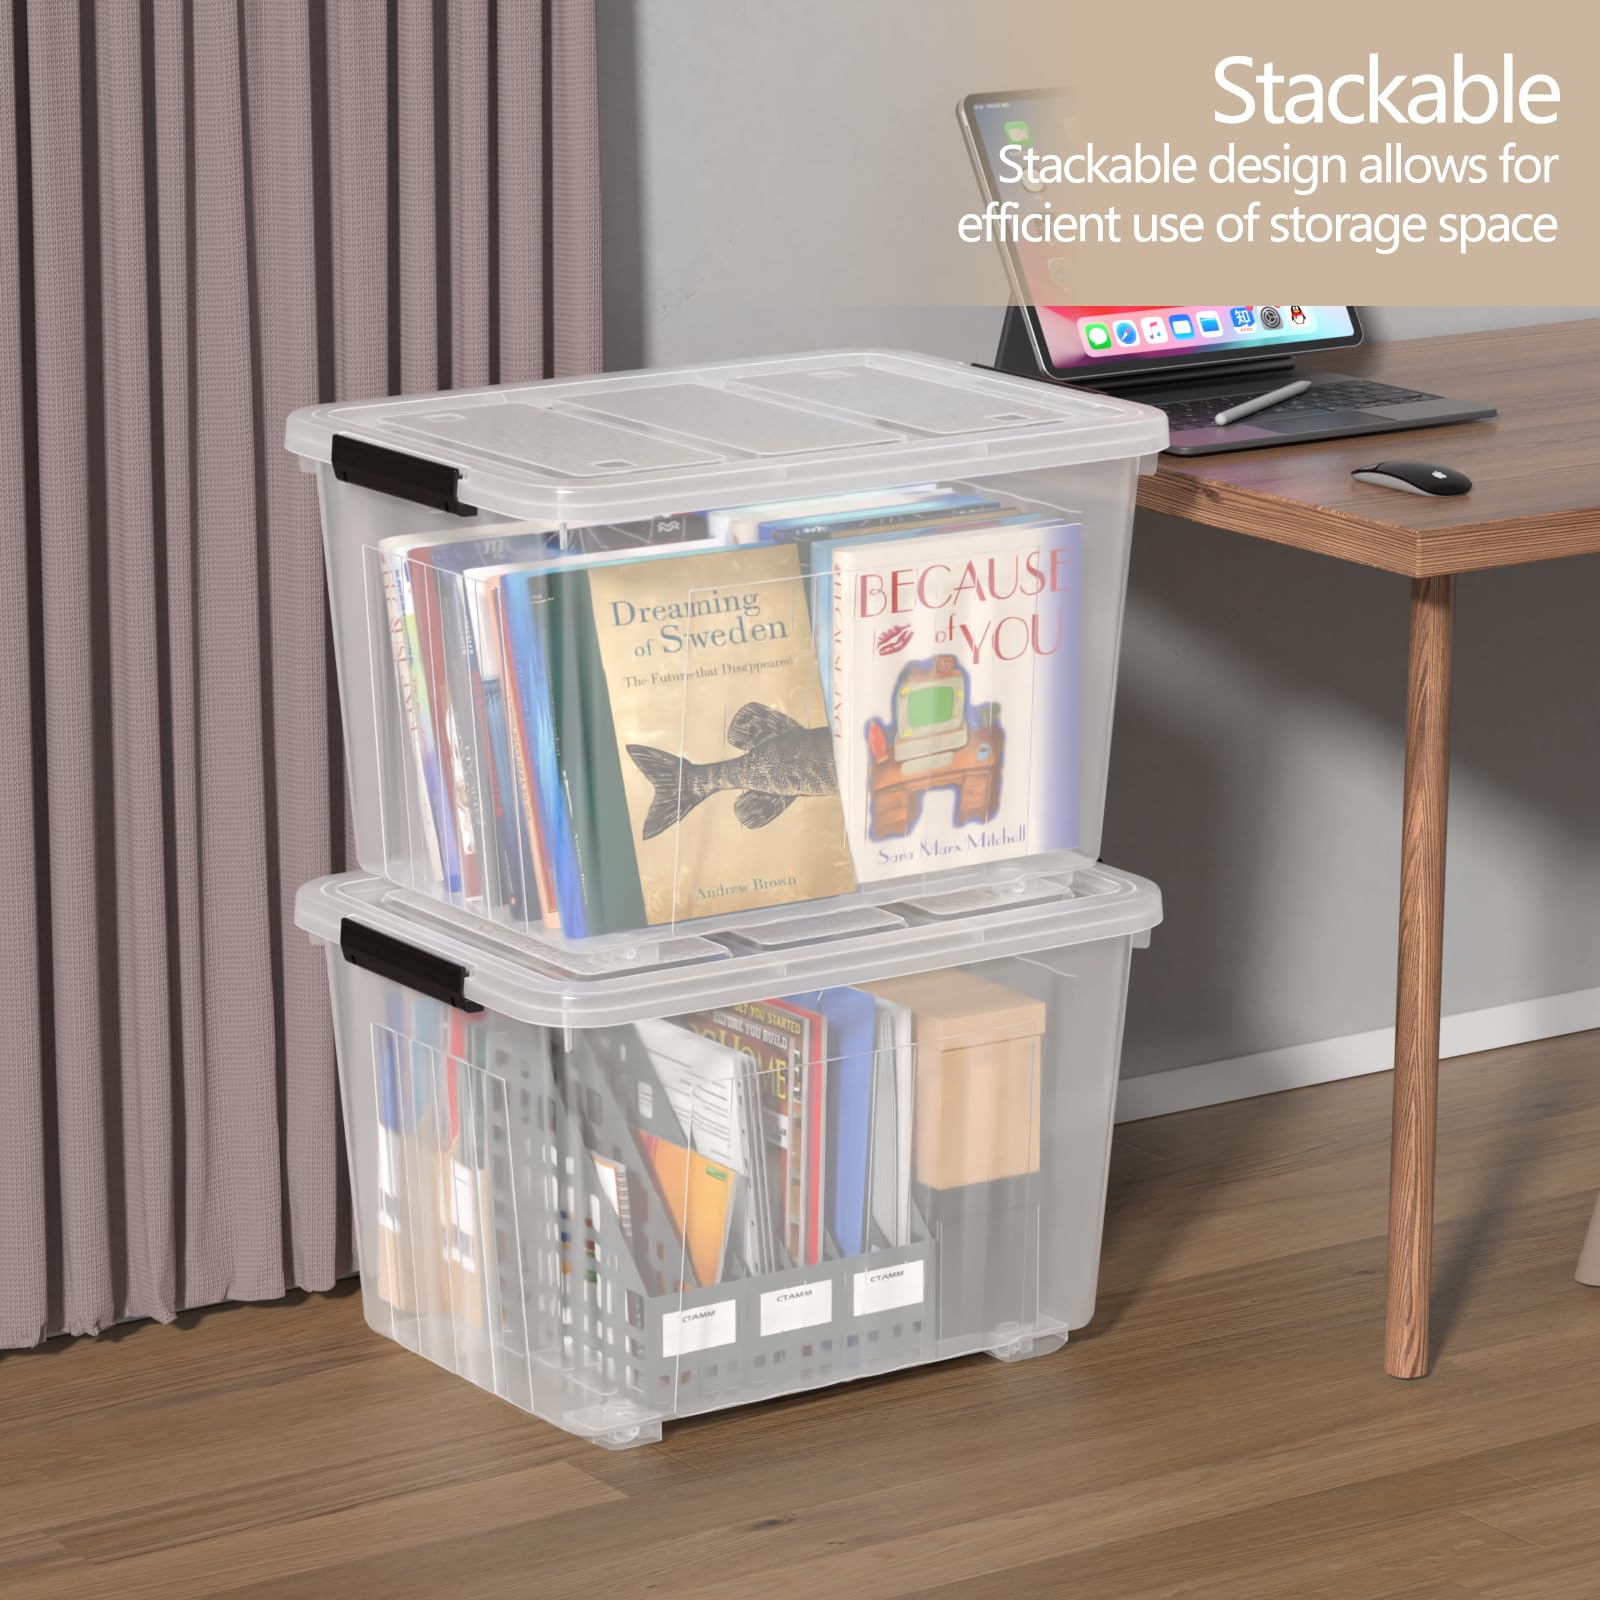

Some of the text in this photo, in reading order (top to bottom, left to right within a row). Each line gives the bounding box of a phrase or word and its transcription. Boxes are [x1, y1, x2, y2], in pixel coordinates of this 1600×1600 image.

[860, 547, 1072, 618] BECAUSE
[611, 590, 761, 627] Dreaming
[634, 616, 789, 657] of Sweden
[935, 608, 1064, 664] of YOU
[624, 675, 648, 689] The
[879, 824, 1026, 865] Sara Marx Mitchell
[697, 876, 798, 899] Andrew Brown
[746, 1022, 761, 1041] YOU
[763, 1029, 788, 1050] BUILD
[767, 1012, 801, 1034] STARTED
